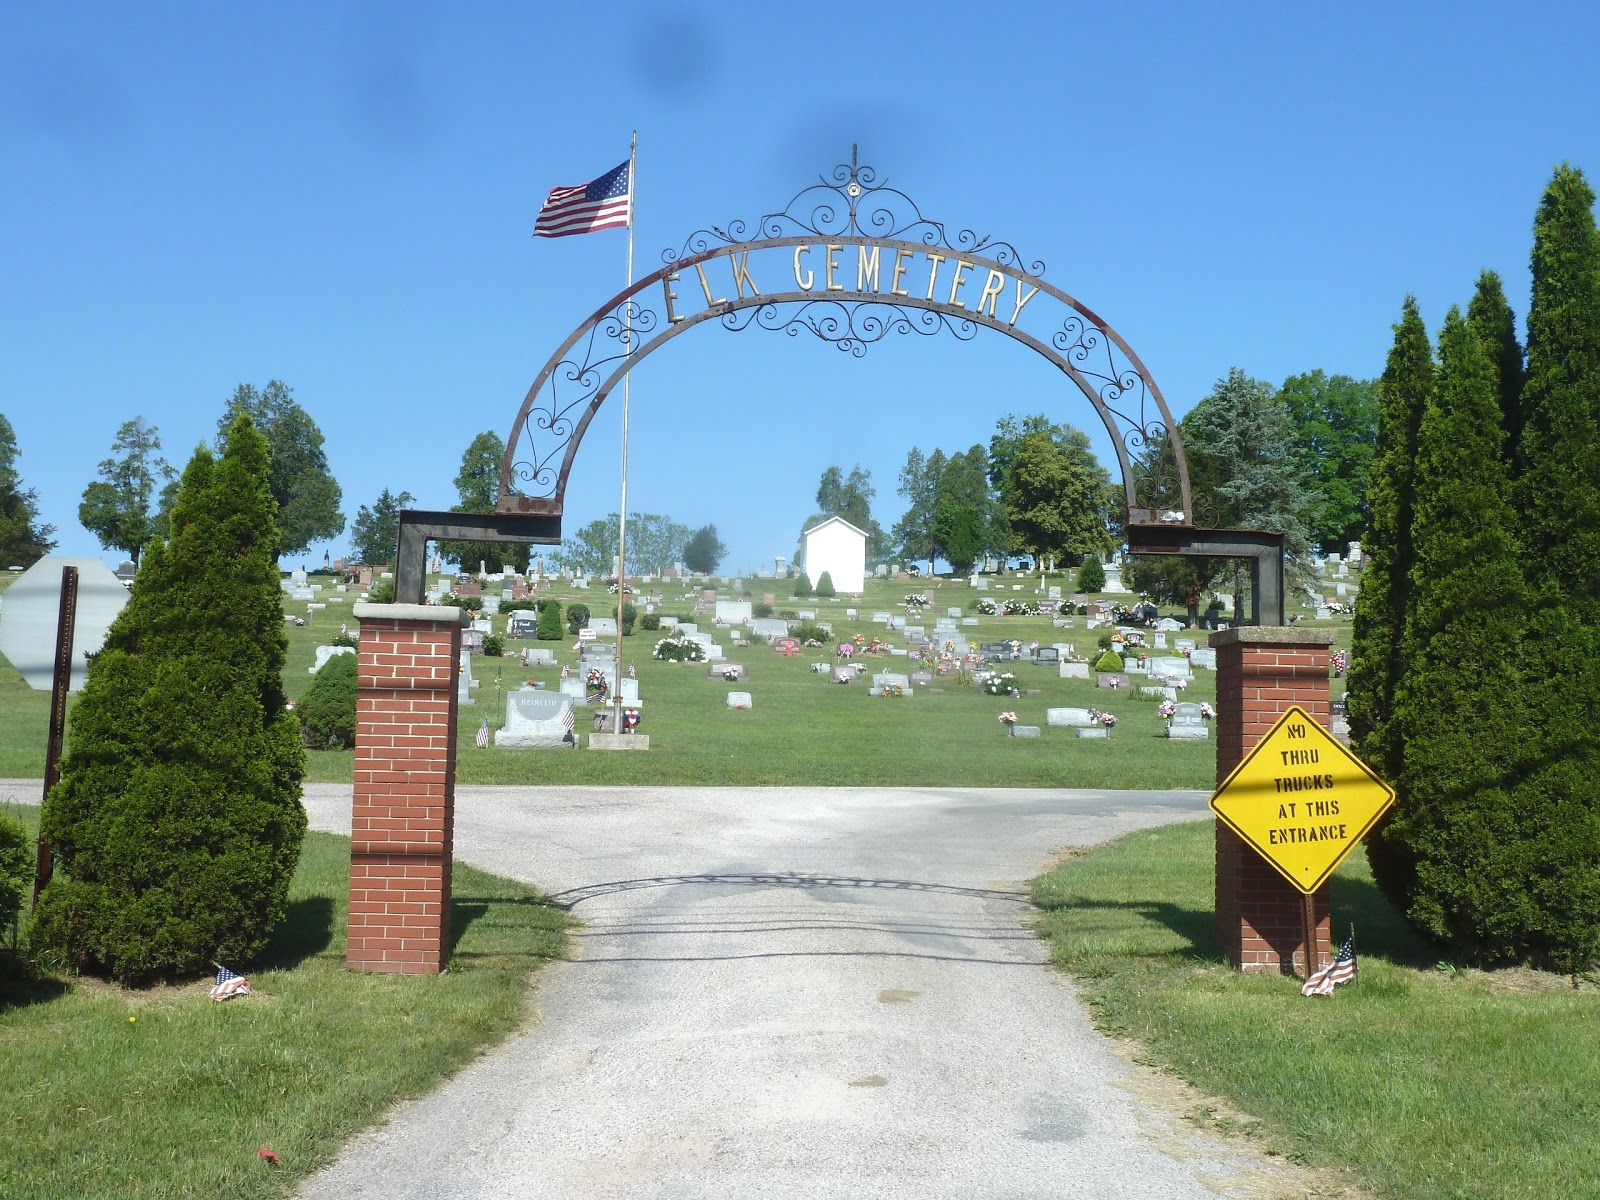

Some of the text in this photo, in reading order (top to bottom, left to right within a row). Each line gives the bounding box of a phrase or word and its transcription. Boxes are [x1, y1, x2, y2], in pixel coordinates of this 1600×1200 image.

[662, 243, 1040, 326] ELK CEMETERY
[1287, 724, 1306, 739] NO
[1281, 749, 1319, 766] THRU
[1274, 774, 1334, 793] TRUCKS
[1278, 800, 1340, 819] AT THIS
[1269, 824, 1348, 845] ENTRANCE
